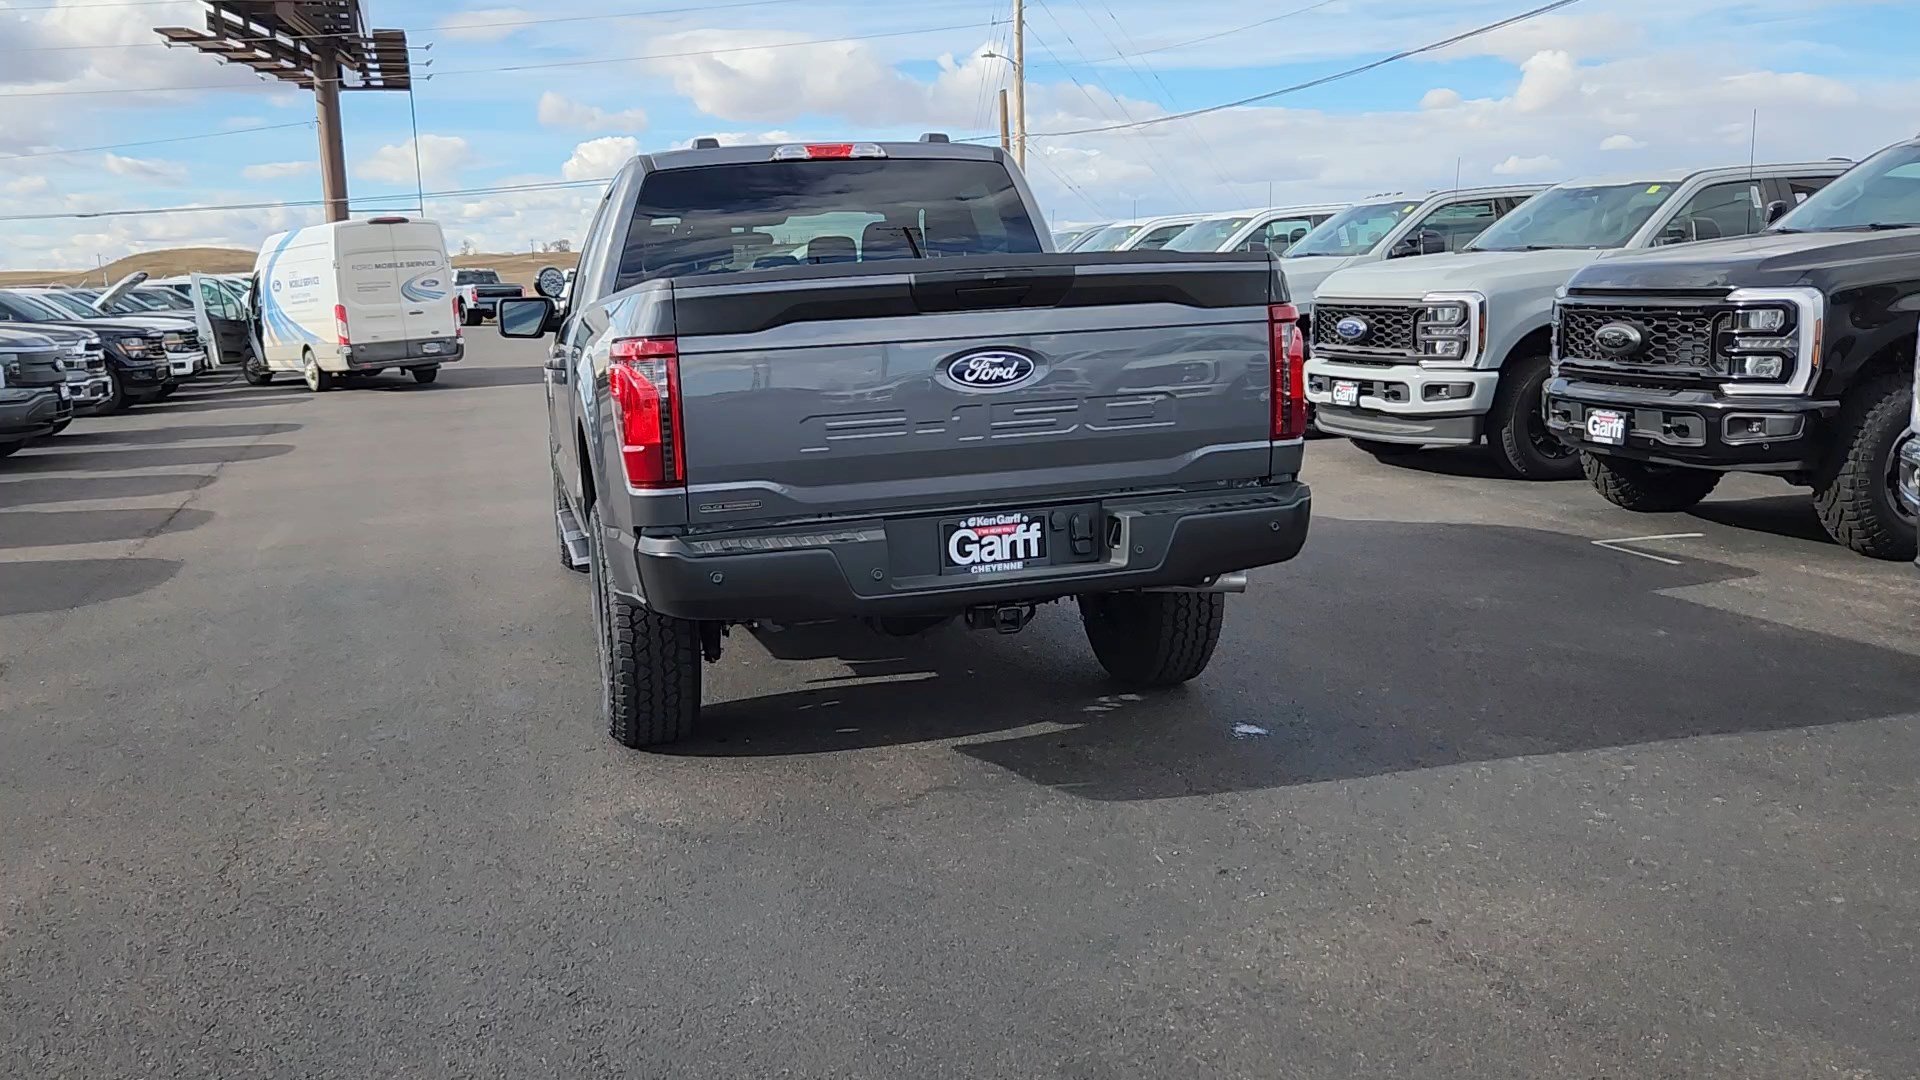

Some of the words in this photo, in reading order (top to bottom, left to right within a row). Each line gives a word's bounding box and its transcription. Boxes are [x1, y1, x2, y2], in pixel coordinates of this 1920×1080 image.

[406, 260, 437, 268] SERVICE
[964, 357, 1018, 381] Ford
[1333, 385, 1358, 402] Garff
[1587, 415, 1625, 438] Garff
[976, 516, 996, 527] Ken
[996, 513, 1021, 526] Garff
[948, 522, 1042, 565] Garff
[970, 561, 1024, 574] CHEYENNE
